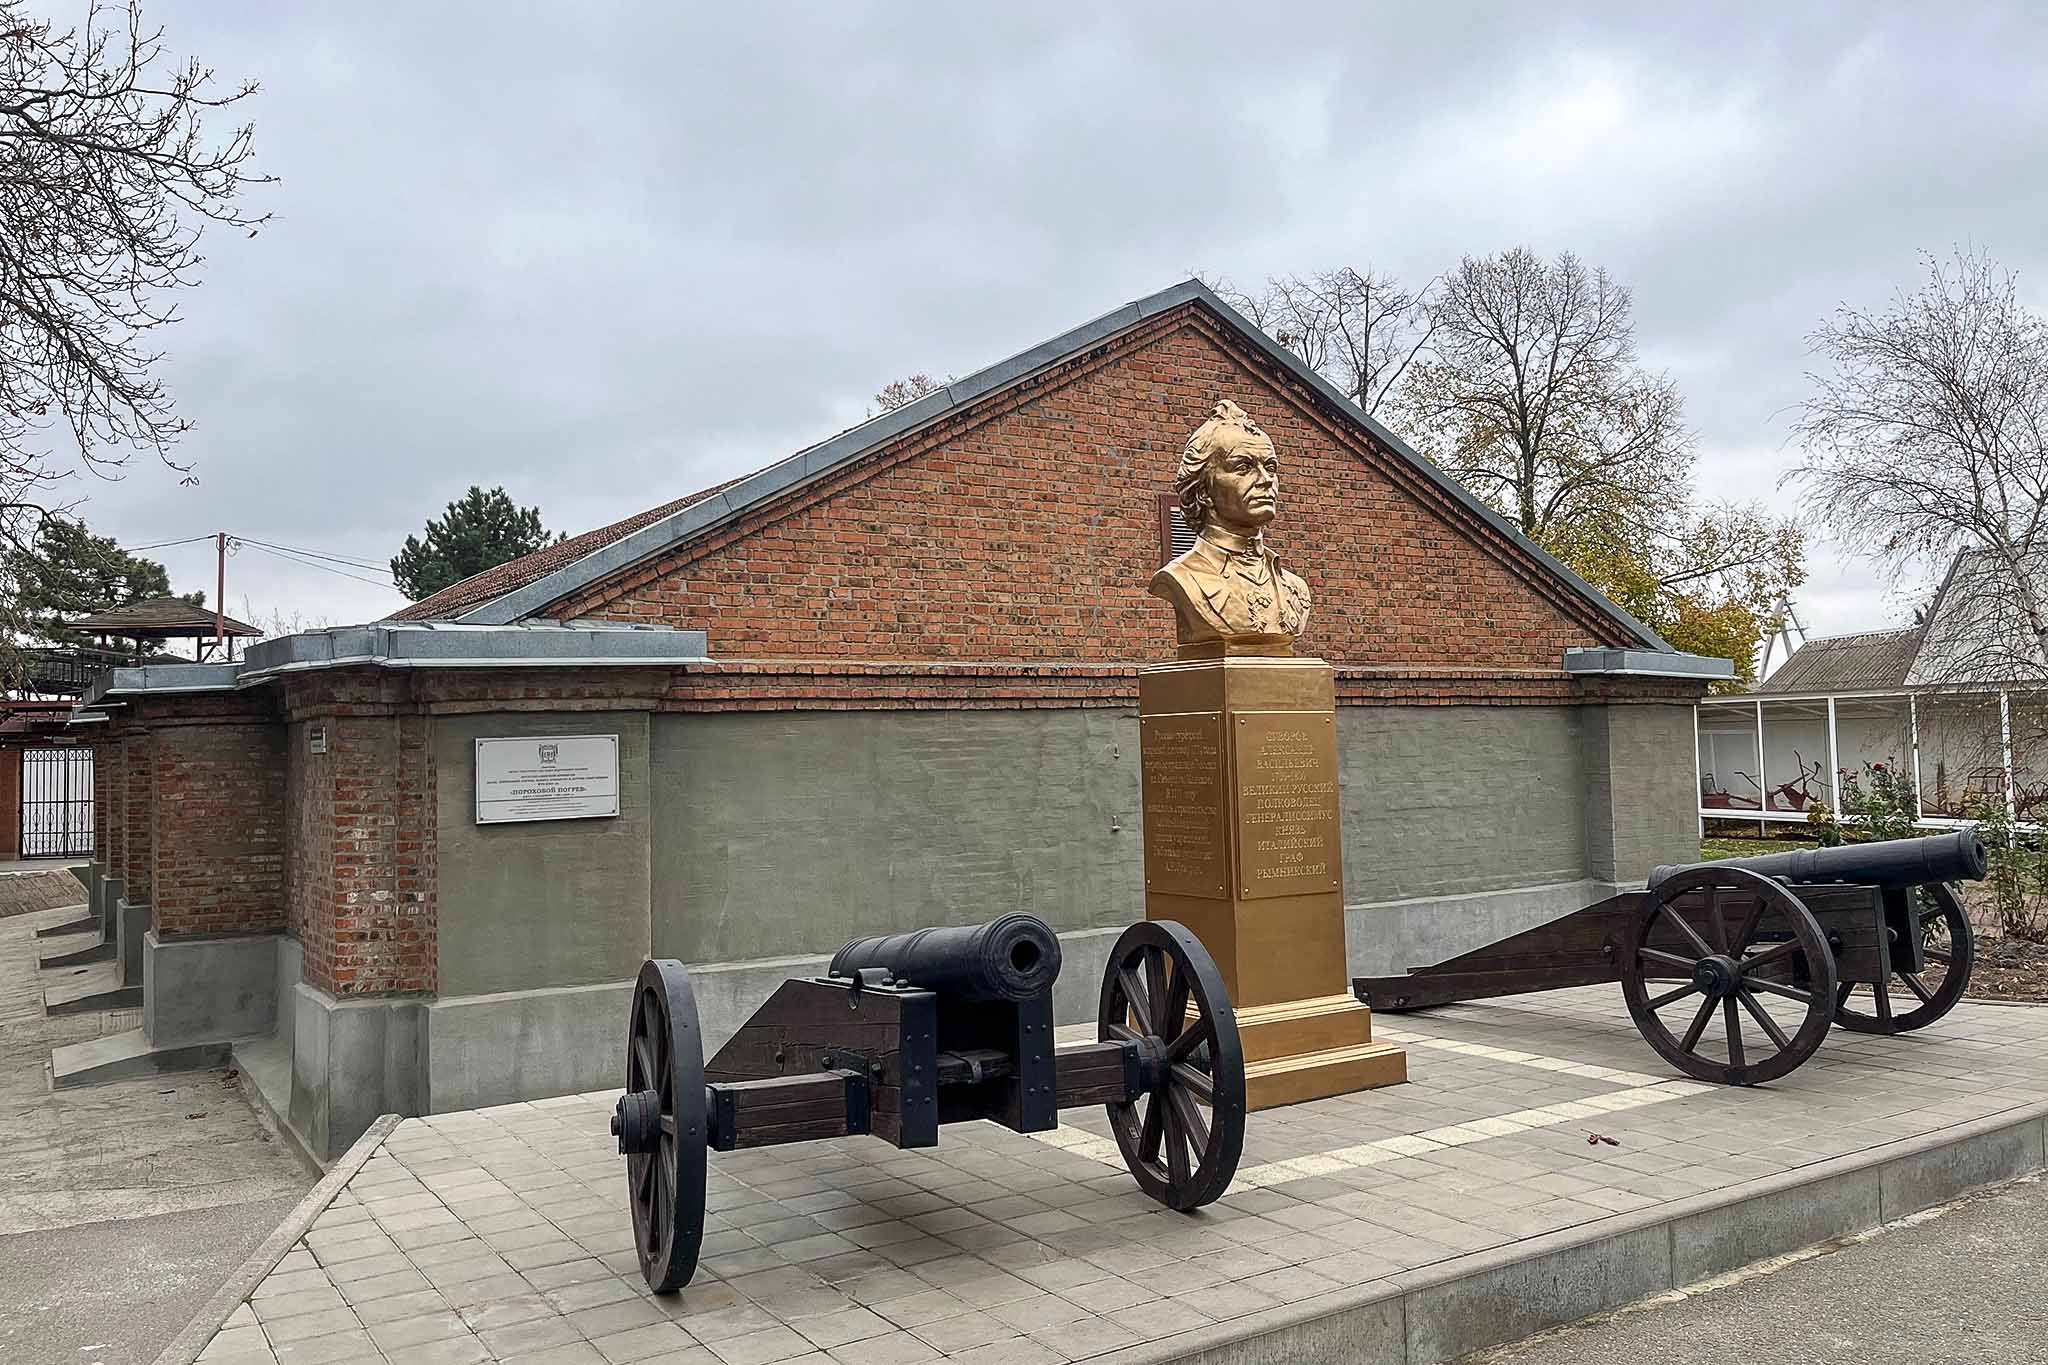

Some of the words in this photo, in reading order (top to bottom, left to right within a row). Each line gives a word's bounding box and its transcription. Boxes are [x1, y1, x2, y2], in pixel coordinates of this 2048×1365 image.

[1256, 759, 1320, 769] ВАСИЛЬЕВИЧ
[1291, 782, 1335, 794] РУССКИЙ
[1256, 797, 1321, 809] ПОЛКОВОДЕЦ
[1245, 809, 1335, 824] ГЕНЕРАЛИССИМУС
[1257, 836, 1325, 851] ИТАЛИЙСКИЙ
[1280, 852, 1304, 864] ГРАФ
[1257, 862, 1328, 879] РЫМНИКСКИЙ
